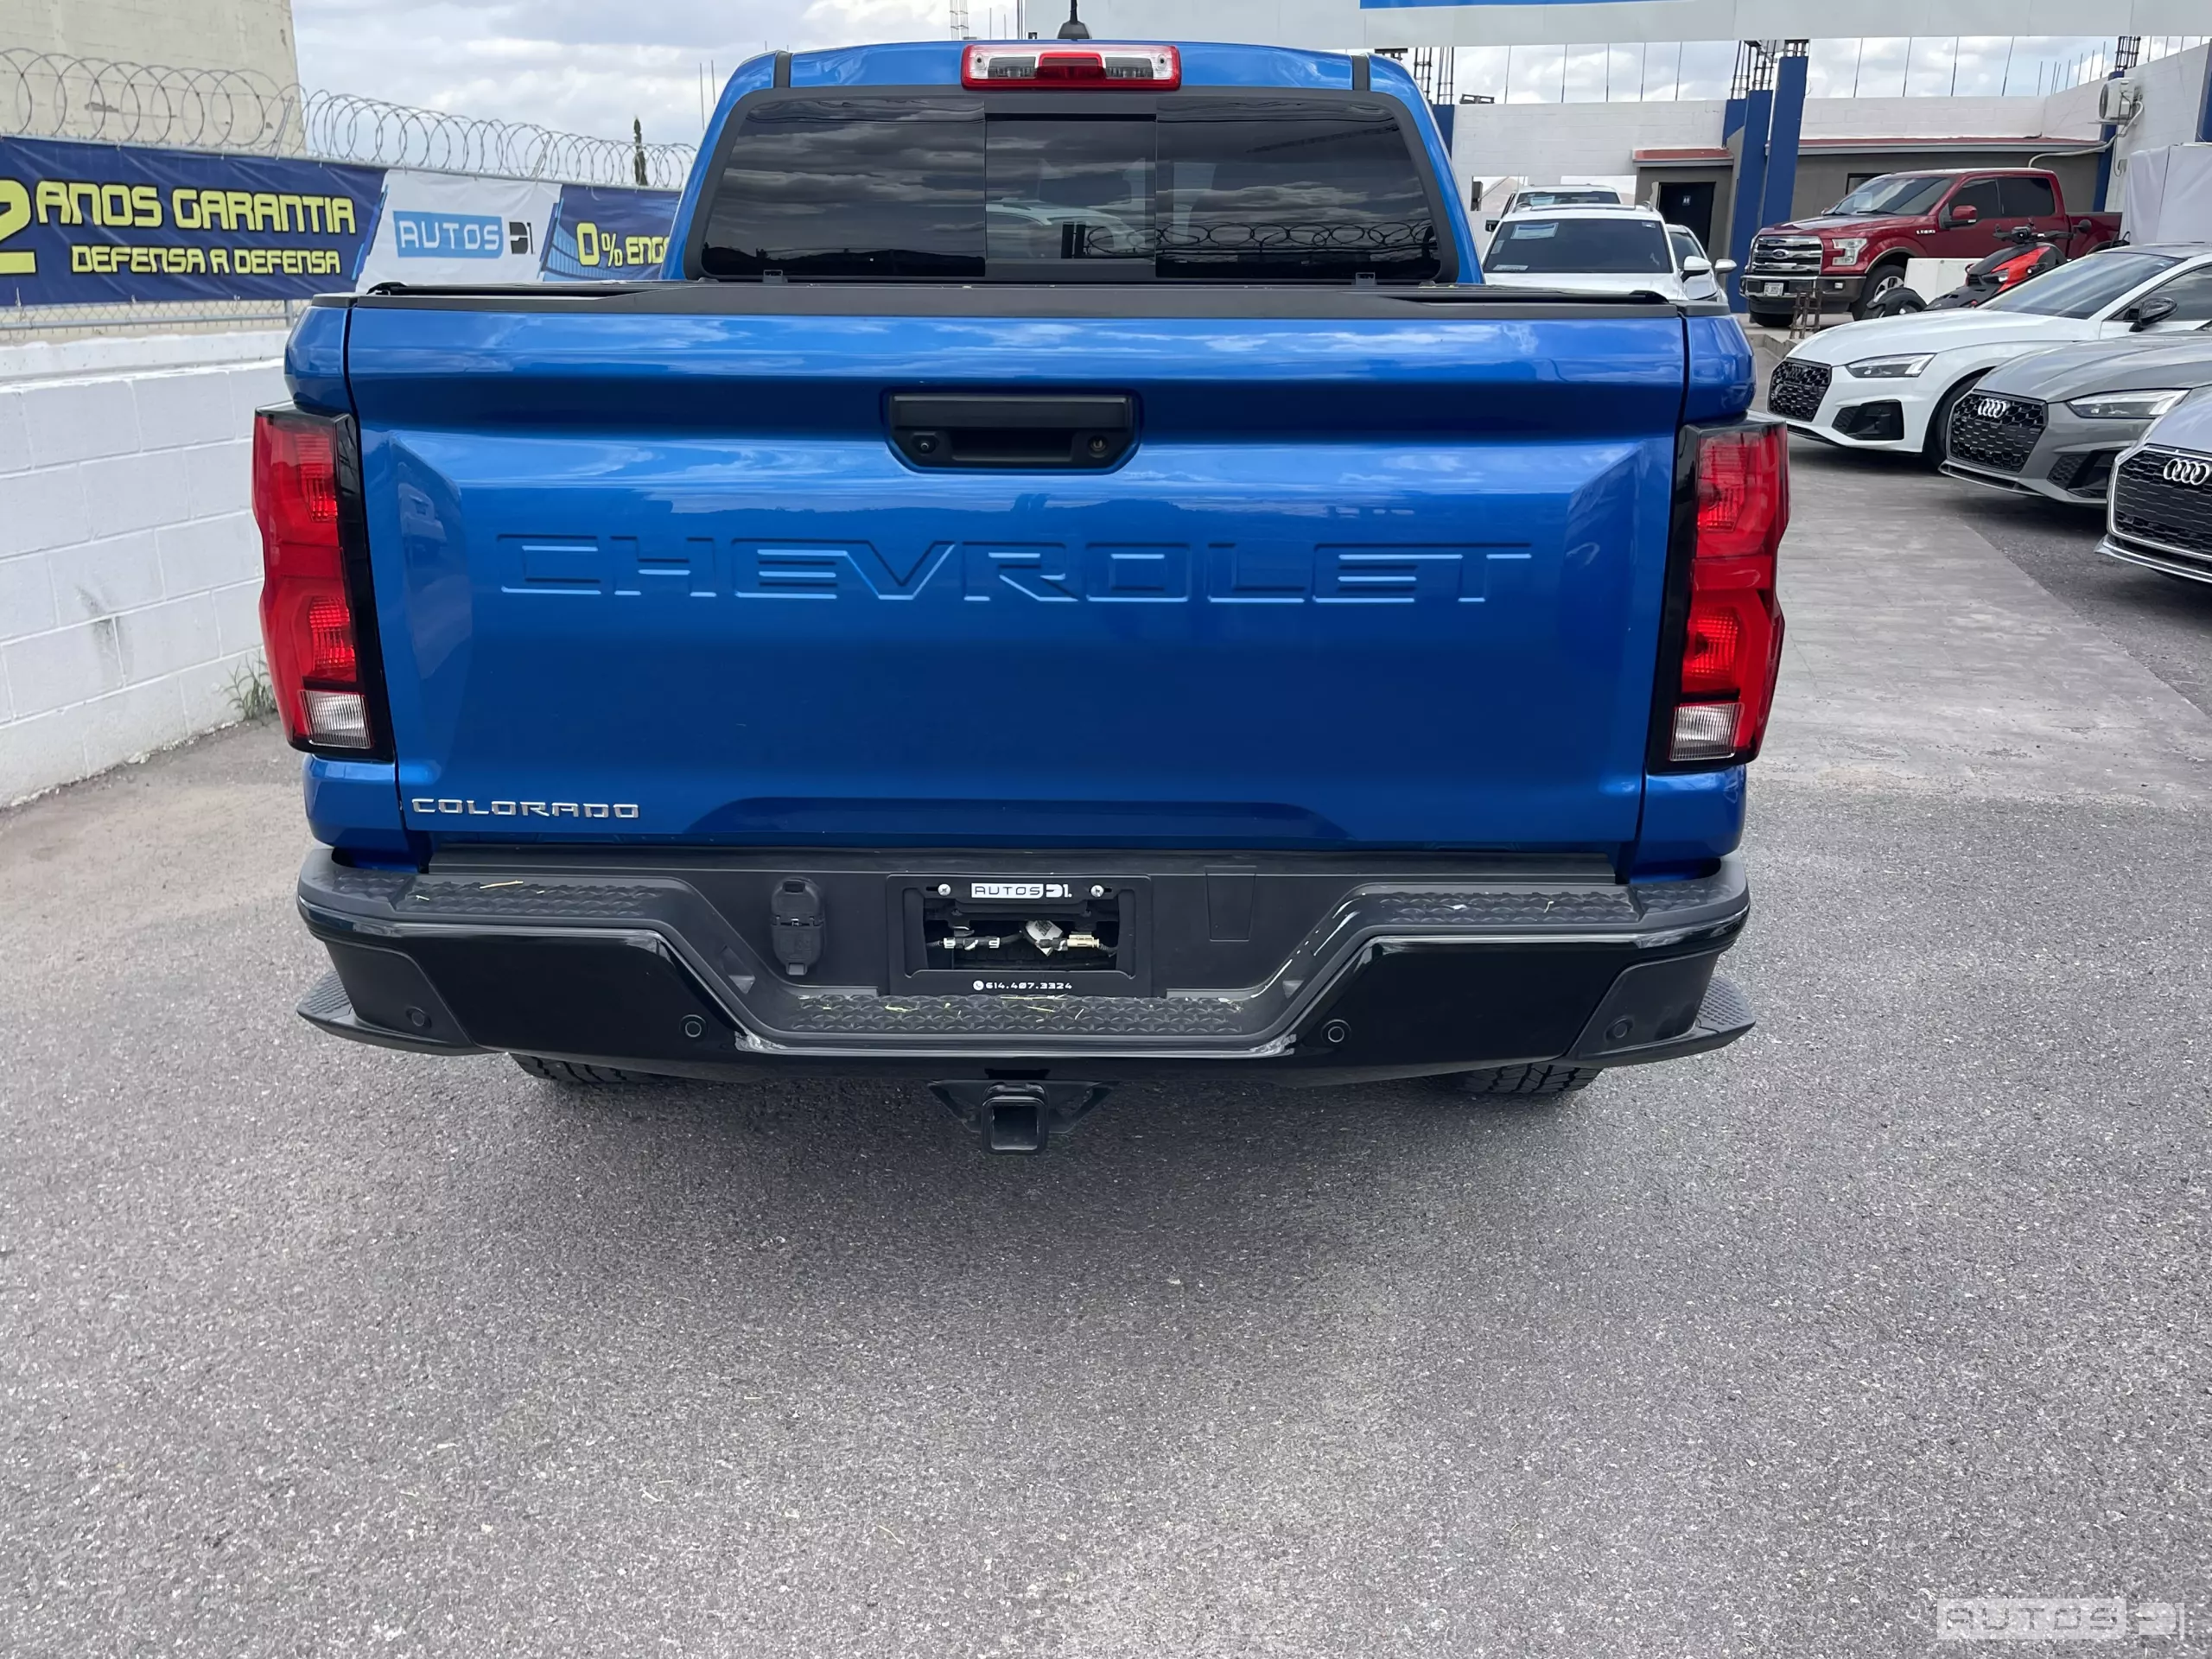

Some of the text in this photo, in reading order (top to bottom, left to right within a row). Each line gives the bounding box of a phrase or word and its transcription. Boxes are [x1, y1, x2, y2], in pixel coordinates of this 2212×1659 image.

[0, 179, 36, 274] 2
[173, 189, 356, 234] GARANTIA
[399, 220, 499, 251] AUTOS
[72, 245, 340, 275] DEFENSA A DEFENSA
[497, 533, 1533, 604] CHEVROLET
[411, 798, 639, 819] COLORADO
[975, 886, 1040, 895] AUTOS
